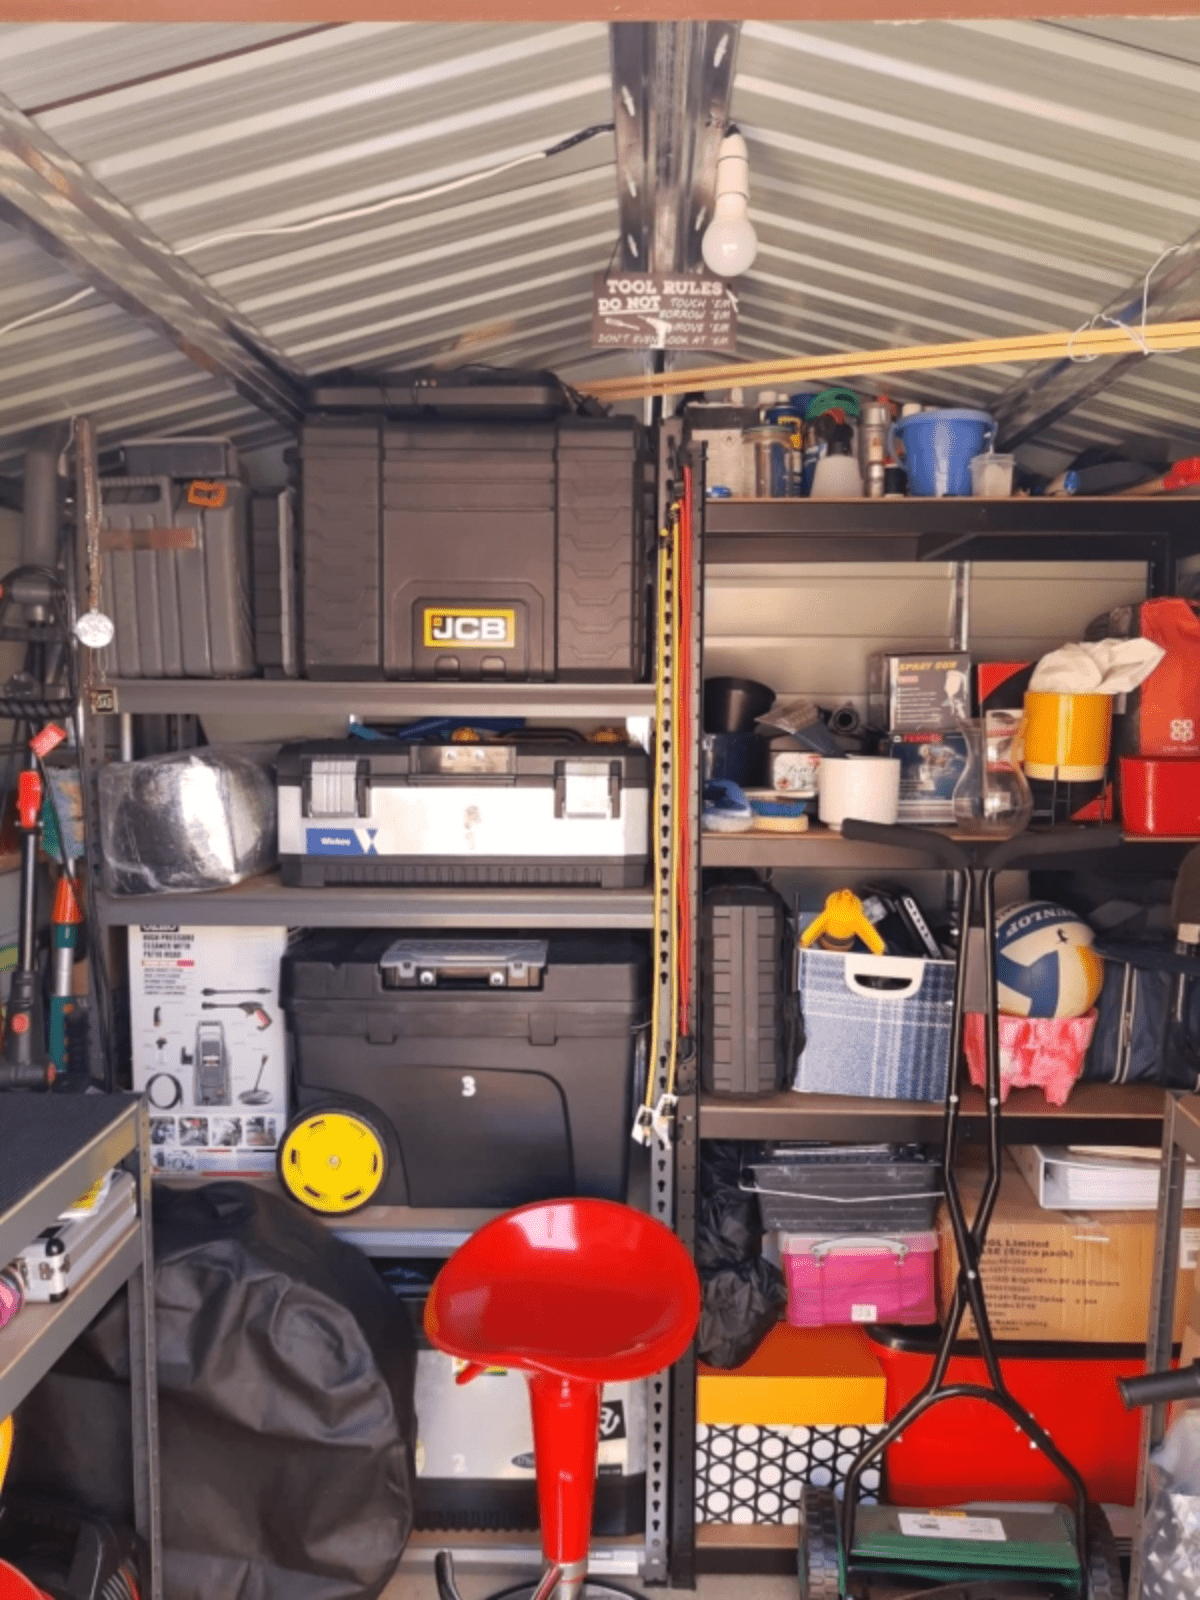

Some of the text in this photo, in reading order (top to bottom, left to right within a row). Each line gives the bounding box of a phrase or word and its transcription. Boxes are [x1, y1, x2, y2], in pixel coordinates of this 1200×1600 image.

[606, 280, 722, 296] TOOL RULES
[598, 298, 622, 311] DO
[626, 295, 660, 311] NOT
[670, 298, 707, 308] TOUCH
[659, 310, 705, 320] BORROW
[673, 323, 704, 333] MOVE
[692, 336, 707, 345] AT
[433, 616, 506, 640] JCB
[899, 662, 932, 672] SPRAY
[1005, 907, 1079, 938] DUNLOP
[461, 1075, 477, 1097] 3
[1005, 1239, 1049, 1249] Limited
